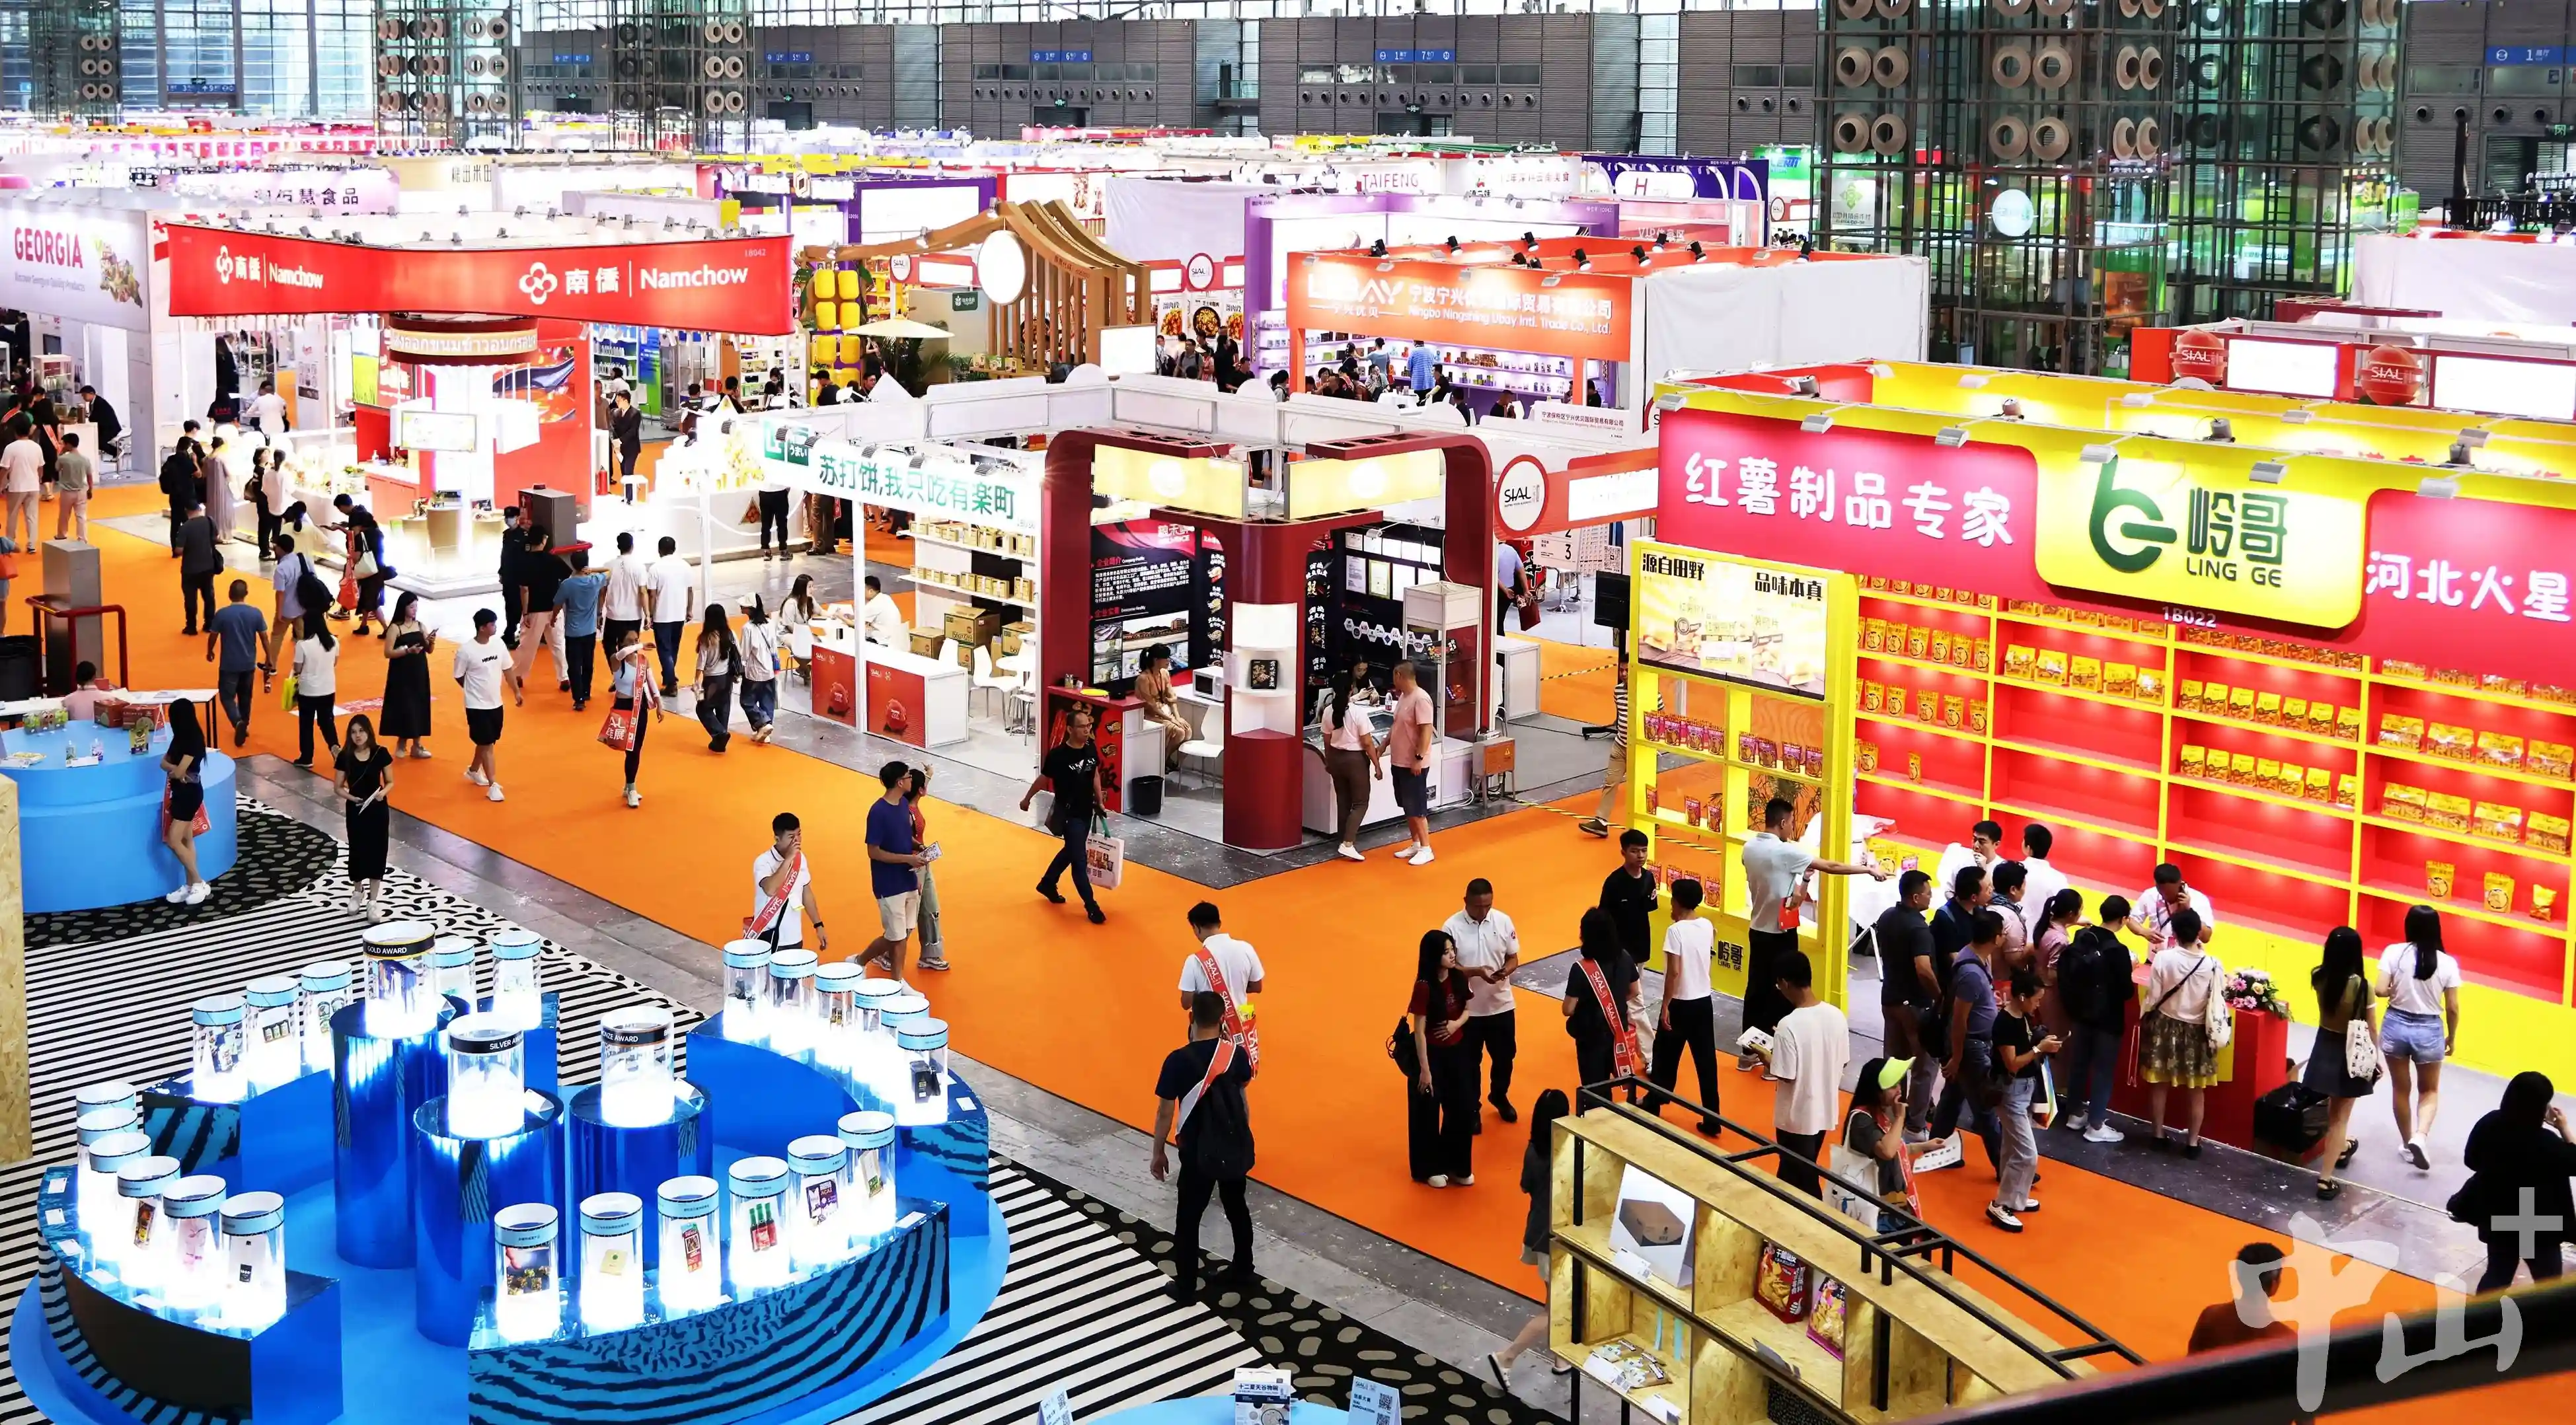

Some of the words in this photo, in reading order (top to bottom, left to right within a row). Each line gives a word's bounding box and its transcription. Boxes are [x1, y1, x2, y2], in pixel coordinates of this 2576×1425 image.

[1361, 174, 1419, 189] TAIFENG
[15, 227, 83, 269] GEORGIA
[268, 264, 324, 289] Namchow
[640, 264, 748, 289] Namchow
[2181, 349, 2211, 362] SIAL
[2371, 367, 2403, 381] SIAL
[1504, 486, 1531, 503] SIAL
[1685, 451, 2014, 548] 红薯制品专家
[2187, 487, 2289, 565] 岭哥
[1565, 544, 1572, 560] 3
[1642, 553, 1704, 581] 源自田野
[2186, 556, 2238, 582] LING
[2251, 566, 2282, 588] GE
[1755, 572, 1822, 601] 品味本真
[2365, 550, 2571, 623] 河北火星
[2162, 605, 2217, 628] 1B022
[786, 869, 798, 891] SIAL
[767, 898, 782, 915] SIAL
[1718, 940, 1743, 965] 岭哥
[1207, 958, 1219, 980] SIAL
[1593, 971, 1605, 993] SIAL
[489, 1039, 511, 1050] SILVER
